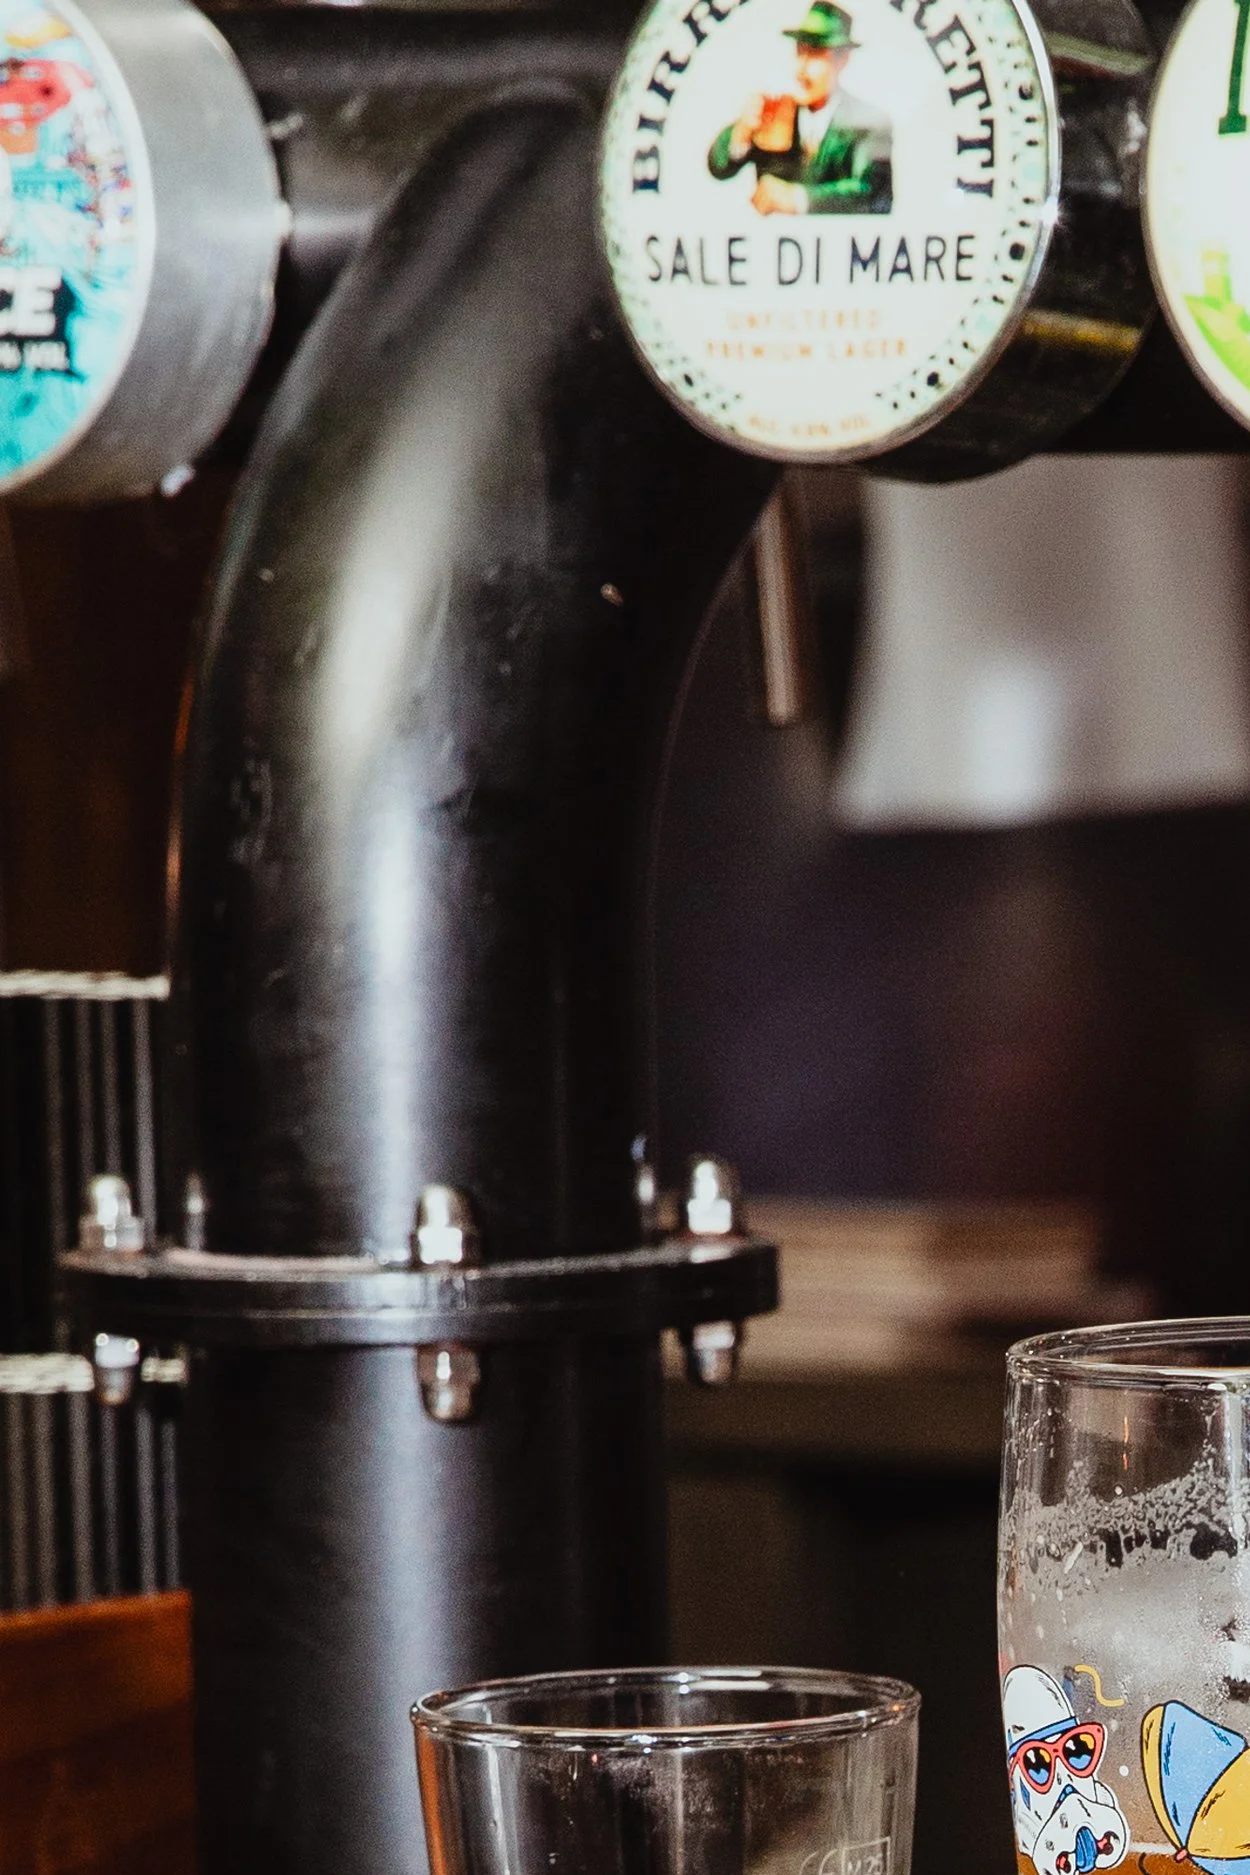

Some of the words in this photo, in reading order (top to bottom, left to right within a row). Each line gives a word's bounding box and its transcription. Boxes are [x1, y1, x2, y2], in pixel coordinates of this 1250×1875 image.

[632, 0, 748, 194] BIRR
[645, 235, 748, 285] SALE
[776, 236, 820, 286] DI
[849, 234, 976, 284] MARE
